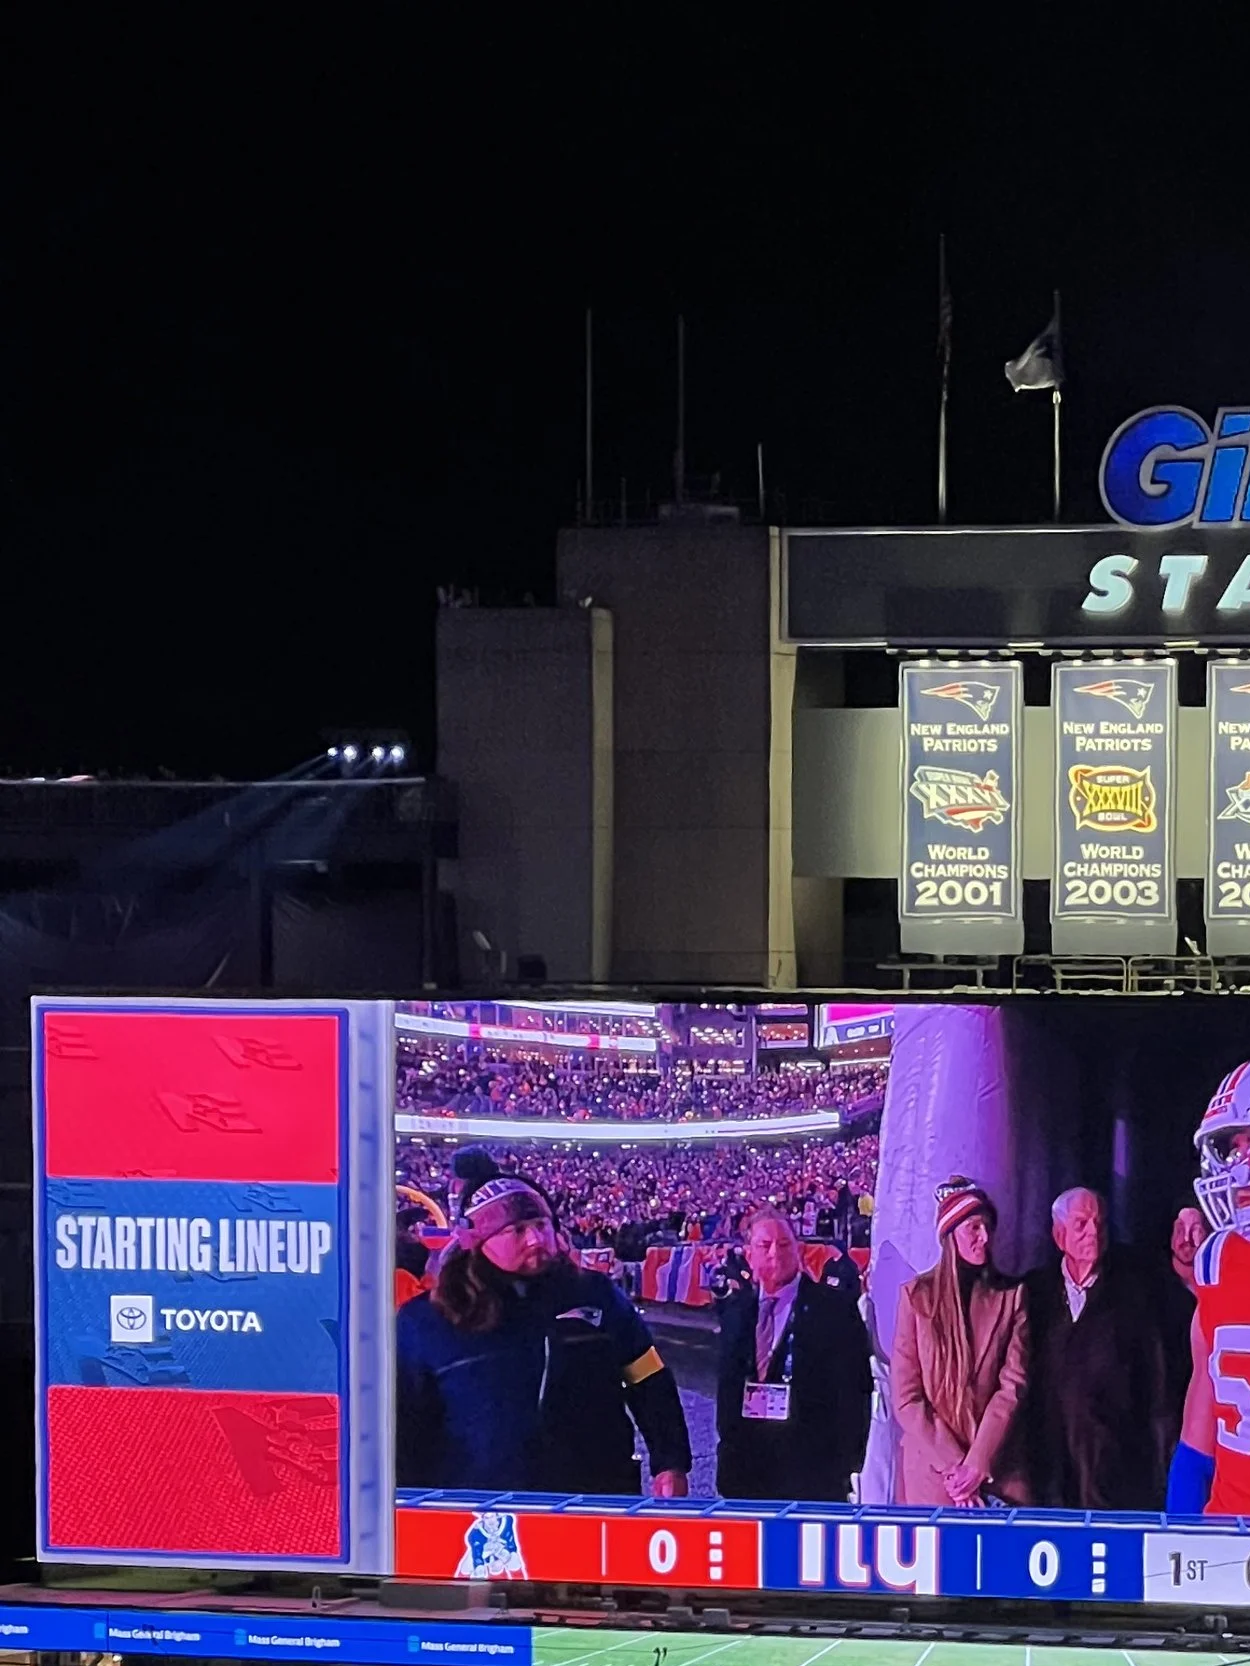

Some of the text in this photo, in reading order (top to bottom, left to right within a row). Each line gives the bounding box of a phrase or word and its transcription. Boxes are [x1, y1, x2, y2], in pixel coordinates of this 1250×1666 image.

[910, 723, 1009, 736] NEW ENGLAND
[1063, 722, 1163, 735] NEW ENGLAND
[1218, 721, 1250, 735] NEW
[923, 738, 998, 752] PATRIOTS
[1075, 737, 1152, 751] PATRIOTS
[1097, 775, 1130, 784] SUPER
[1082, 779, 1145, 817] XXXVIII
[1098, 812, 1128, 821] BOWL
[927, 844, 990, 860] WORLD
[1080, 844, 1144, 859] WORLD
[910, 862, 1008, 878] CHAMPIONS
[1063, 862, 1162, 878] CHAMPIONS
[915, 880, 1001, 906] 2001
[1064, 880, 1160, 906] 2003
[56, 1214, 331, 1274] STARTING LINEUP
[160, 1309, 262, 1332] TOYOTA
[649, 1530, 677, 1574] 0
[1029, 1541, 1059, 1586] 0
[1168, 1551, 1208, 1581] 1ST
[0, 1624, 28, 1636] righam
[249, 1634, 340, 1648] Mass General Brigham
[422, 1641, 514, 1655] Mass General Brigham
